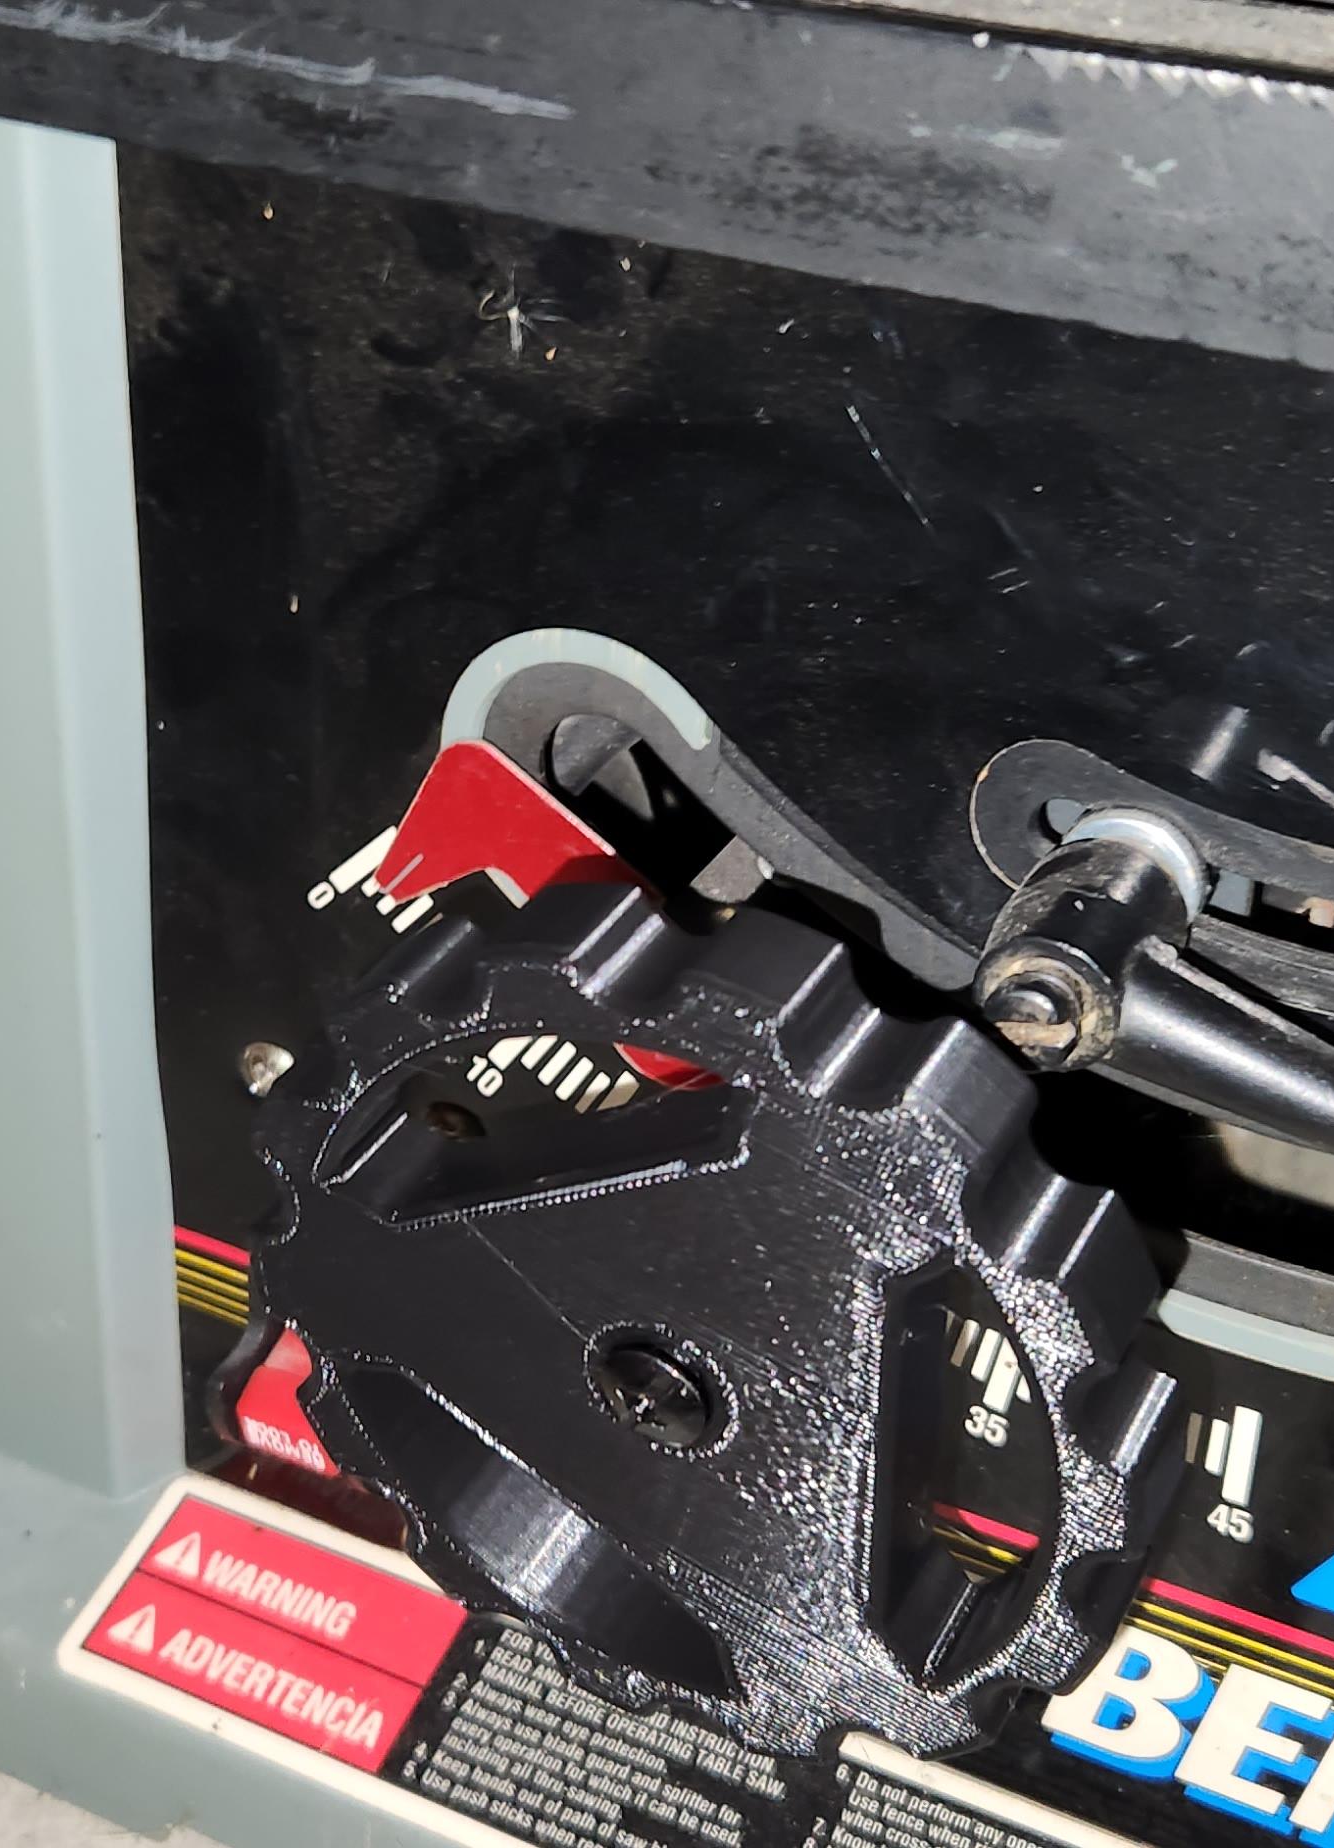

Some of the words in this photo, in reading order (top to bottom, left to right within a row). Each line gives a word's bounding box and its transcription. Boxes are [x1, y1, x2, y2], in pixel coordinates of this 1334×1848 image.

[307, 881, 336, 910] 0
[466, 1054, 504, 1098] 10
[964, 1404, 1009, 1448] 35
[1206, 1503, 1255, 1545] 45
[201, 1549, 357, 1640] WARNING
[490, 1646, 533, 1672] READ
[532, 1664, 565, 1687] AND
[500, 1629, 533, 1651] FOR
[470, 1680, 524, 1713] Always
[524, 1703, 561, 1727] wear
[562, 1719, 592, 1742] eye
[589, 1732, 668, 1774] protection.
[481, 1662, 543, 1699] MANUAL
[546, 1689, 607, 1724] BEFORE
[606, 1713, 694, 1760] OPERATING
[696, 1749, 745, 1782] TABLE
[441, 1733, 511, 1773] including
[510, 1761, 534, 1781] all
[450, 1716, 494, 1744] every
[493, 1734, 564, 1769] operation
[564, 1762, 587, 1782] for
[587, 1773, 633, 1802] which
[633, 1790, 648, 1807] it
[648, 1799, 678, 1820] can
[678, 1808, 700, 1828] be
[459, 1698, 513, 1731] Always
[514, 1722, 542, 1742] use
[542, 1732, 585, 1761] blade
[585, 1752, 632, 1781] guard
[631, 1771, 662, 1792] and
[661, 1783, 718, 1814] splitter
[718, 1803, 743, 1825] for
[422, 1768, 452, 1792] Use
[450, 1782, 490, 1809] push
[489, 1799, 535, 1828] sticks
[534, 1819, 576, 1846] when
[431, 1749, 470, 1778] Keep
[471, 1766, 517, 1798] hands
[517, 1788, 545, 1808] out
[544, 1800, 563, 1815] of
[559, 1807, 597, 1832] path
[597, 1821, 617, 1837] of
[841, 1807, 885, 1836] when
[848, 1787, 880, 1814] Use
[881, 1803, 926, 1832] fence
[928, 1823, 972, 1848] when
[855, 1770, 878, 1792] Do
[880, 1782, 908, 1804] not
[906, 1796, 973, 1831] perform
[973, 1821, 1005, 1845] any
